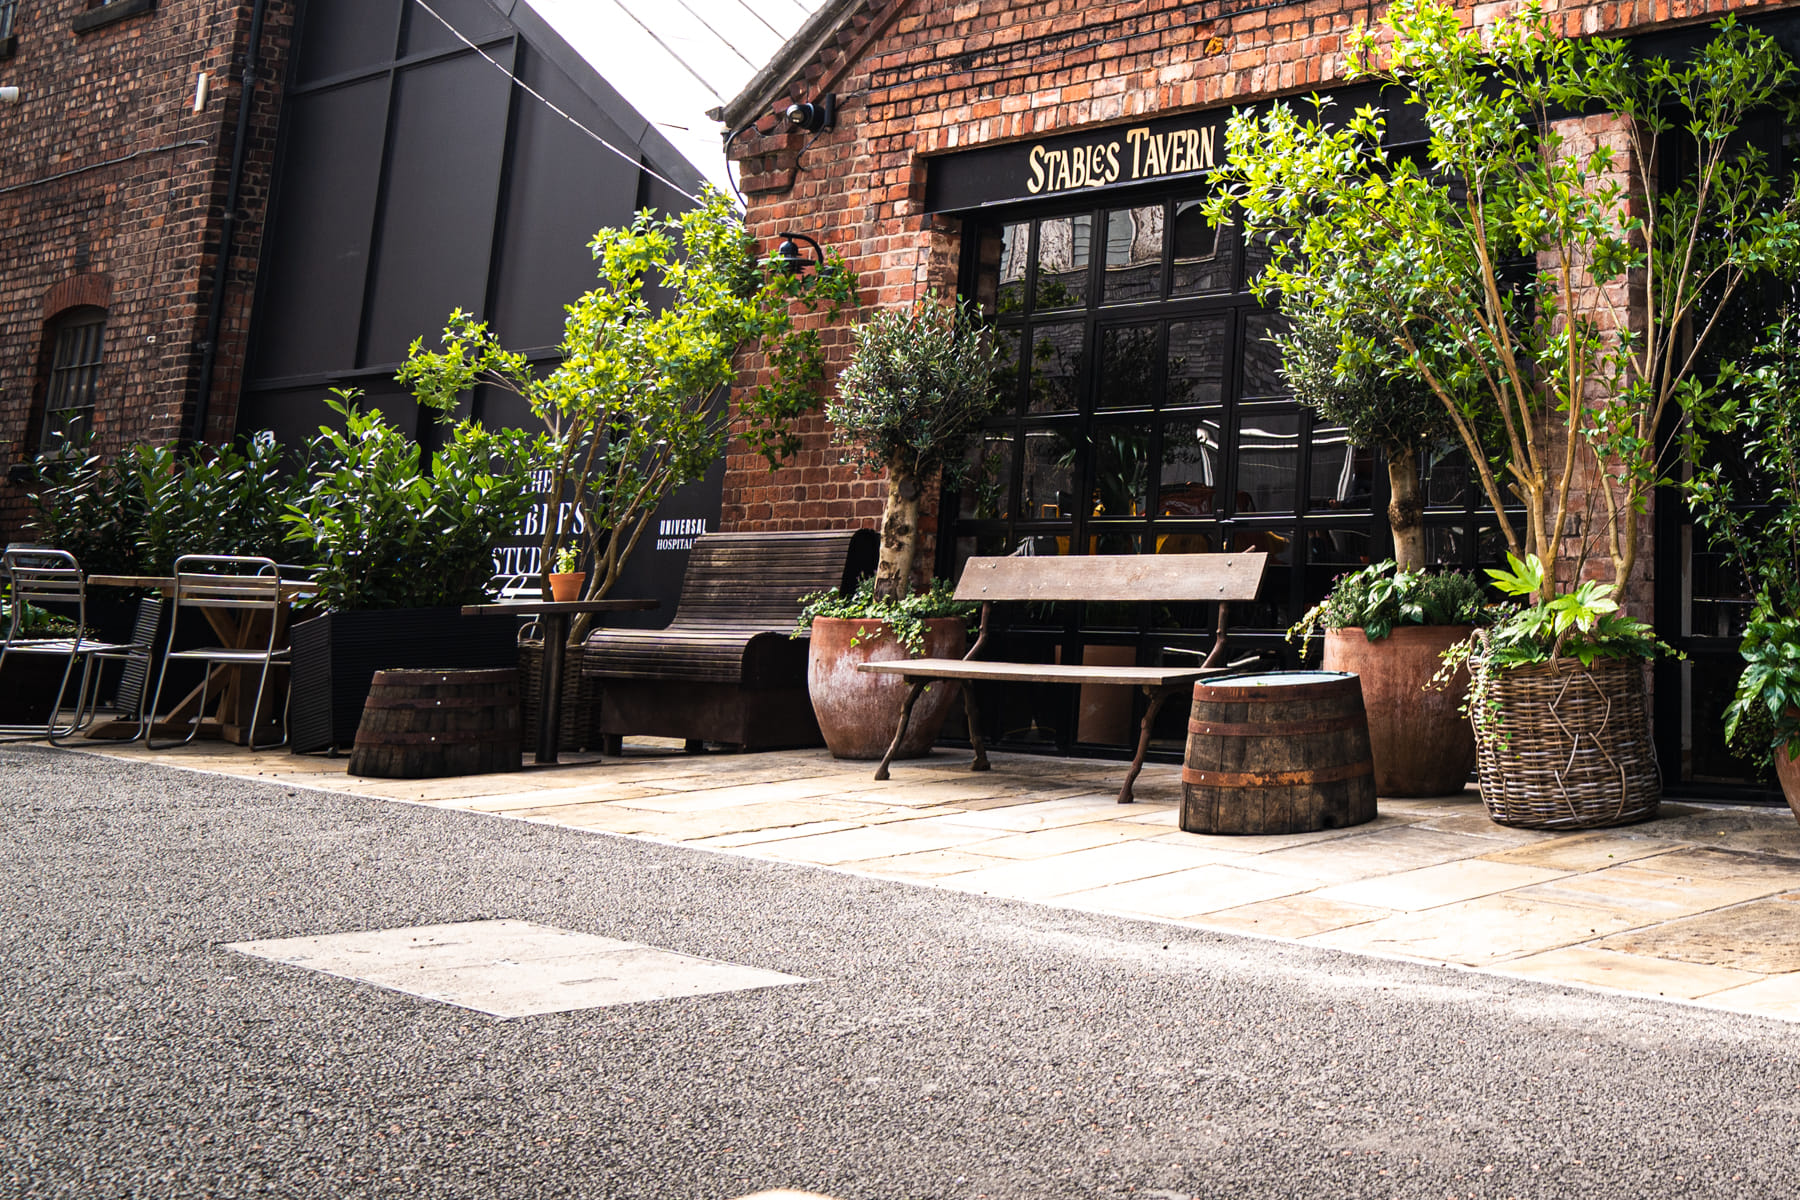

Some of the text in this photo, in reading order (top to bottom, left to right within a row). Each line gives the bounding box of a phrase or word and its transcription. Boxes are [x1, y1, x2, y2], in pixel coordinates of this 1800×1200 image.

[1027, 126, 1216, 194] STABLES TAVERN
[660, 518, 706, 535] UNIVERSAL
